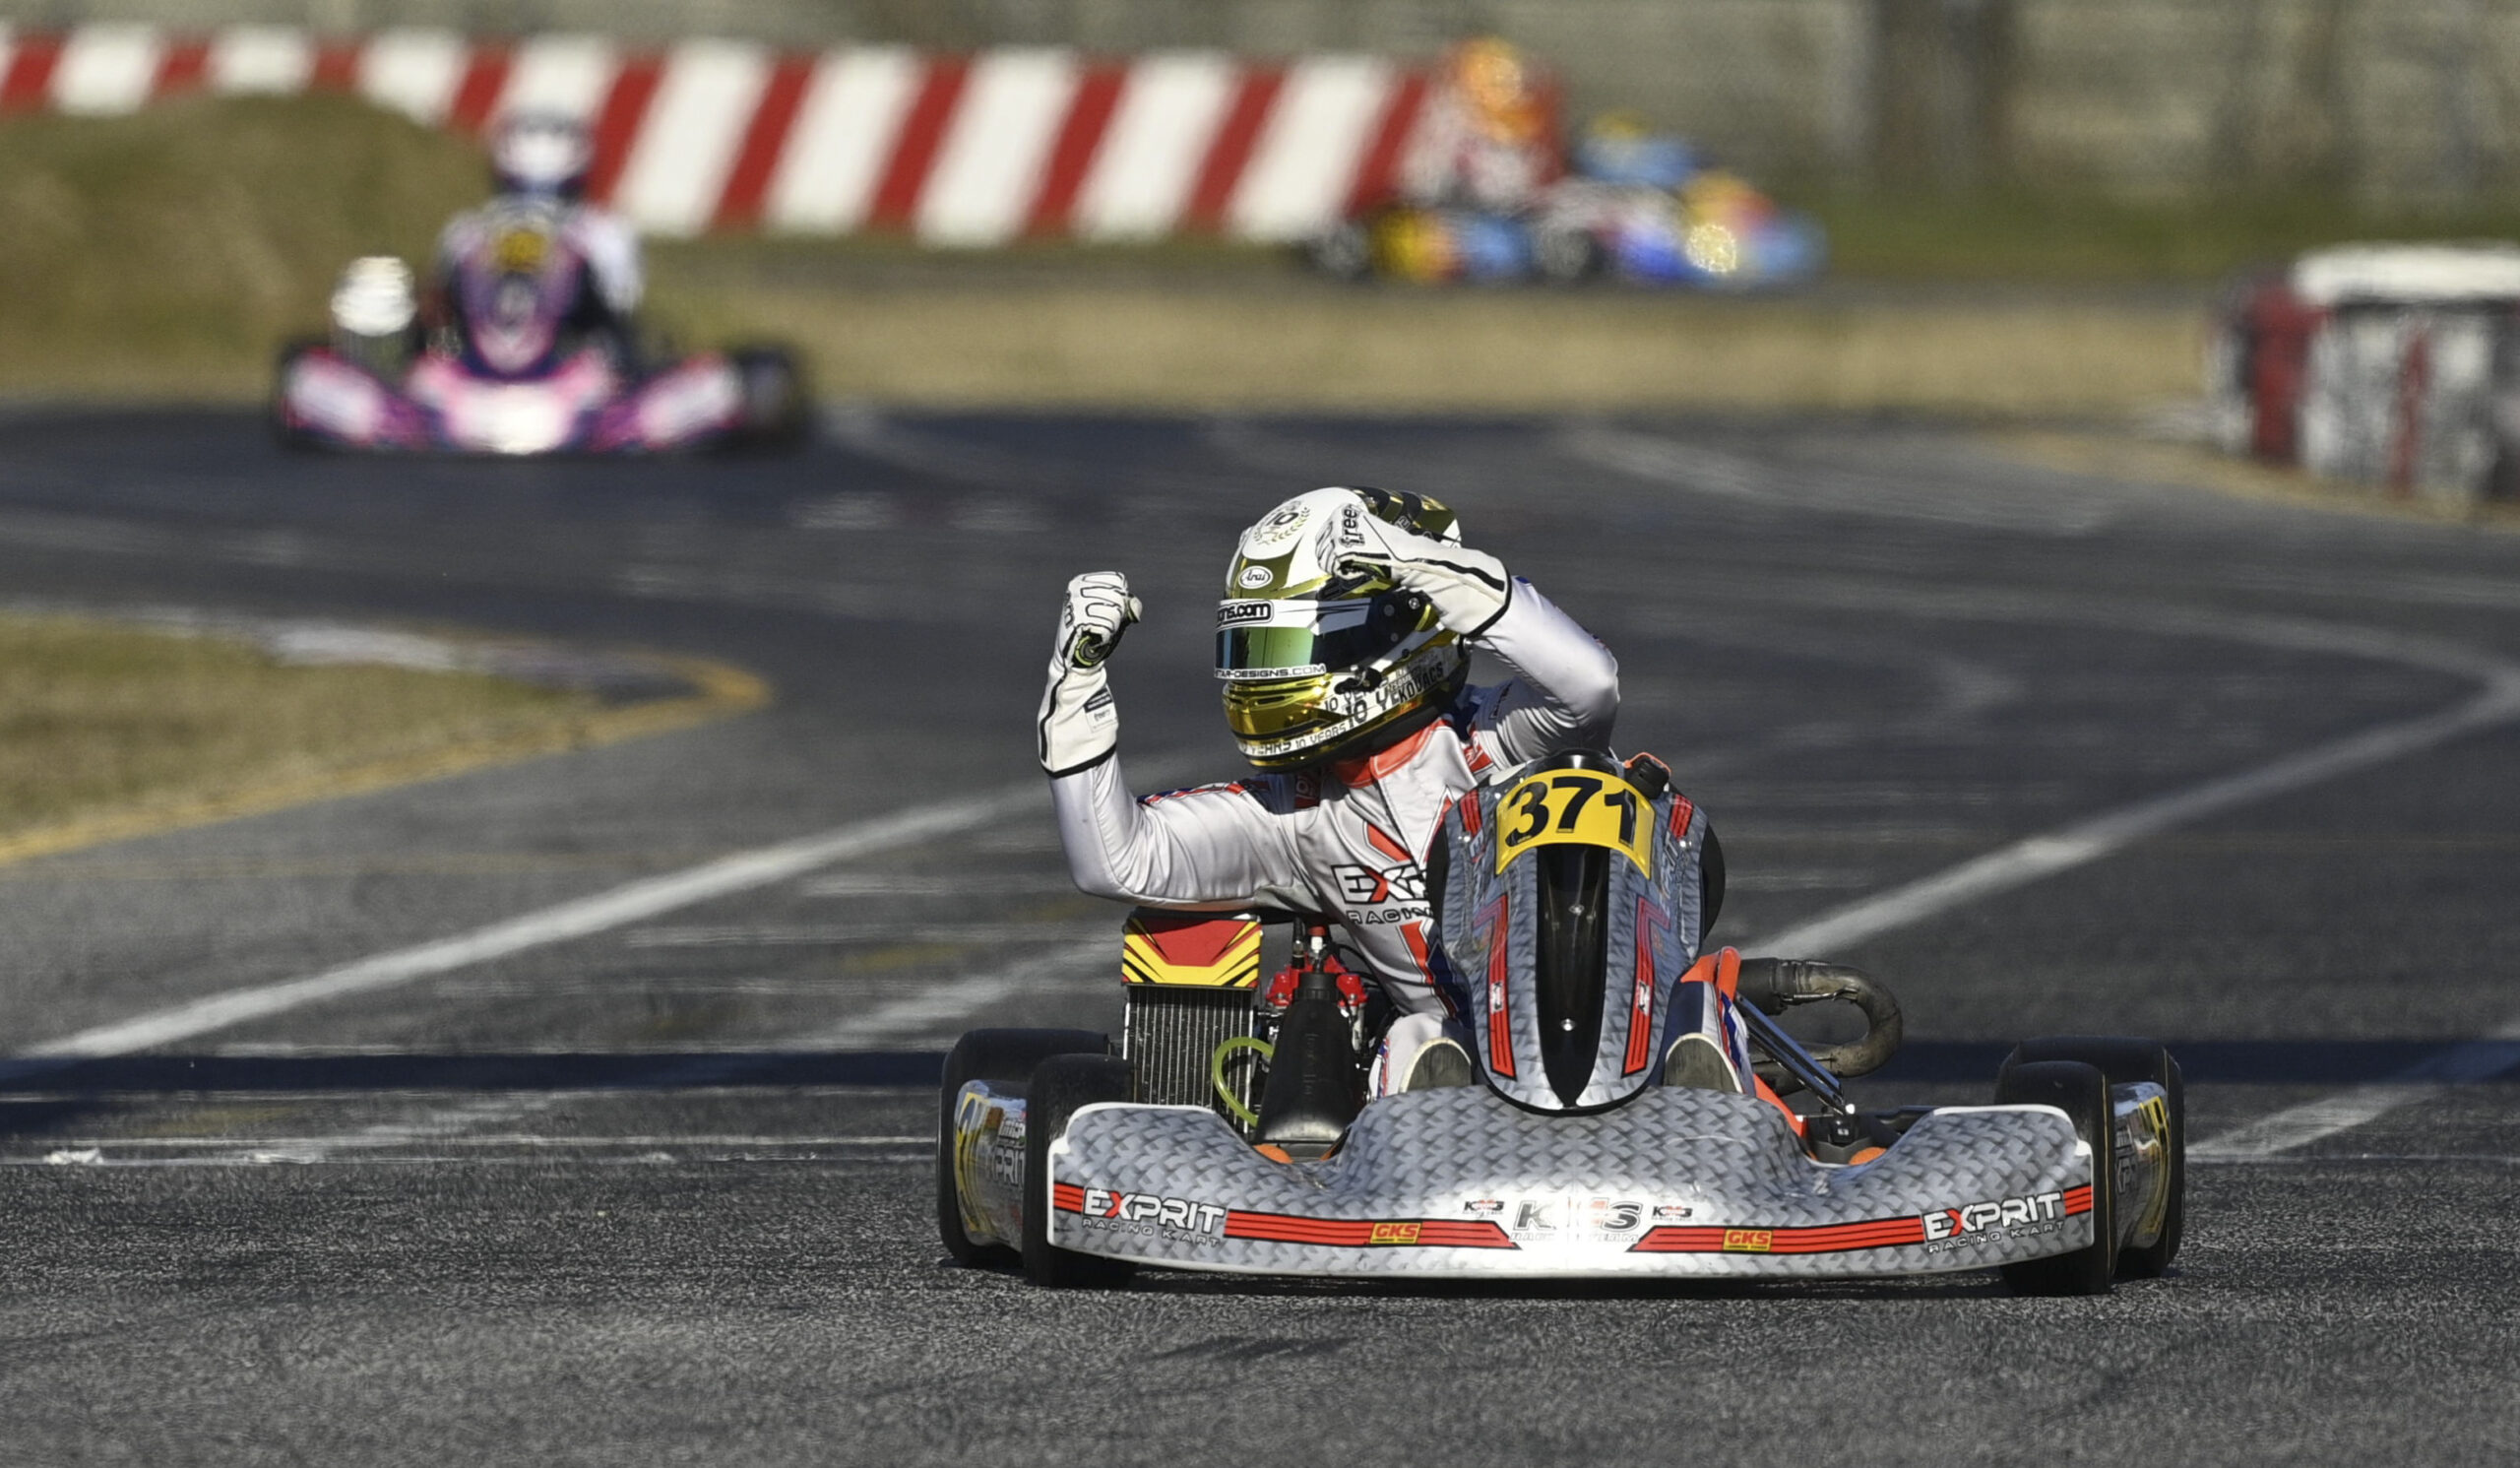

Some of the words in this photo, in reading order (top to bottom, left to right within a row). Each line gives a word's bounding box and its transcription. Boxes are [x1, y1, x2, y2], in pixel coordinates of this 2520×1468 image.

[1242, 569, 1266, 582] Arai
[1505, 777, 1637, 851] 371
[1084, 1187, 1227, 1234] EXPRIT
[1923, 1191, 2063, 1241] EXPRIT
[1375, 1224, 1418, 1238] GKS
[1728, 1231, 1771, 1245] GKS
[1928, 1231, 2001, 1253] RACING
[2010, 1221, 2065, 1239] KART
